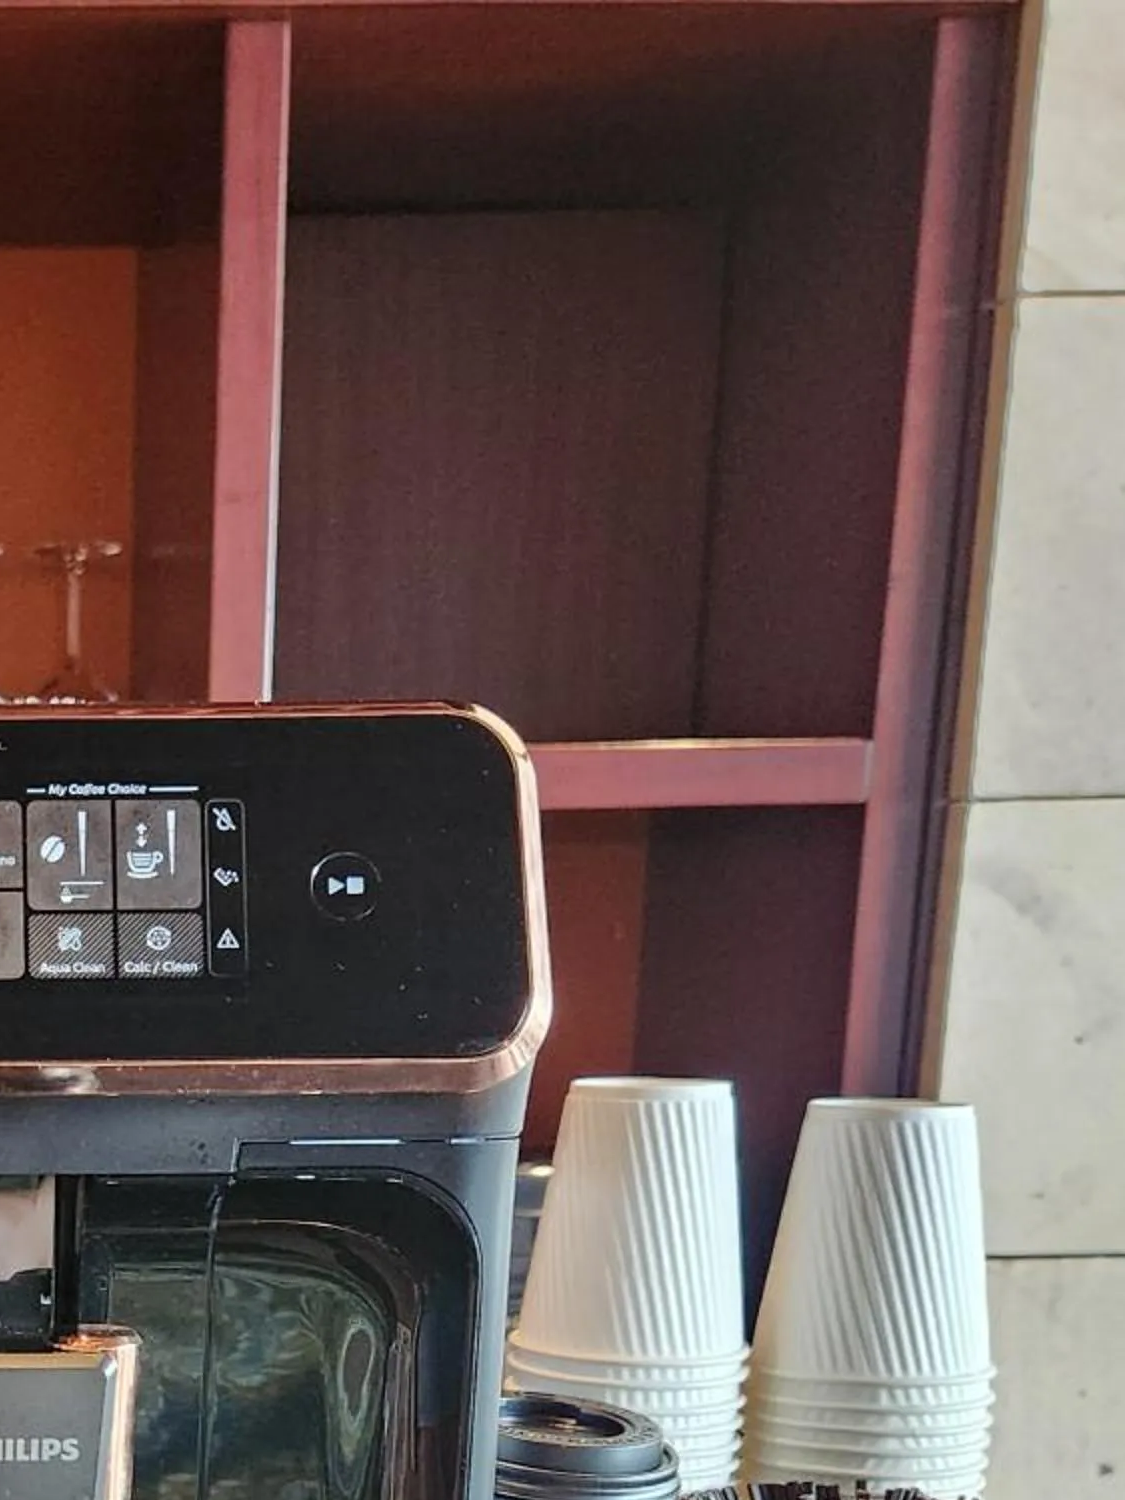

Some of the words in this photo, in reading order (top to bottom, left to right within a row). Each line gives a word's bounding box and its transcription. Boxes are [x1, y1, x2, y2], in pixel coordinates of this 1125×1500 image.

[48, 784, 67, 797] My
[68, 783, 106, 796] Coffee
[107, 783, 147, 795] Choice
[39, 962, 71, 974] Aqua
[73, 961, 106, 973] Clean
[124, 961, 152, 973] Calc
[162, 961, 199, 973] Clean
